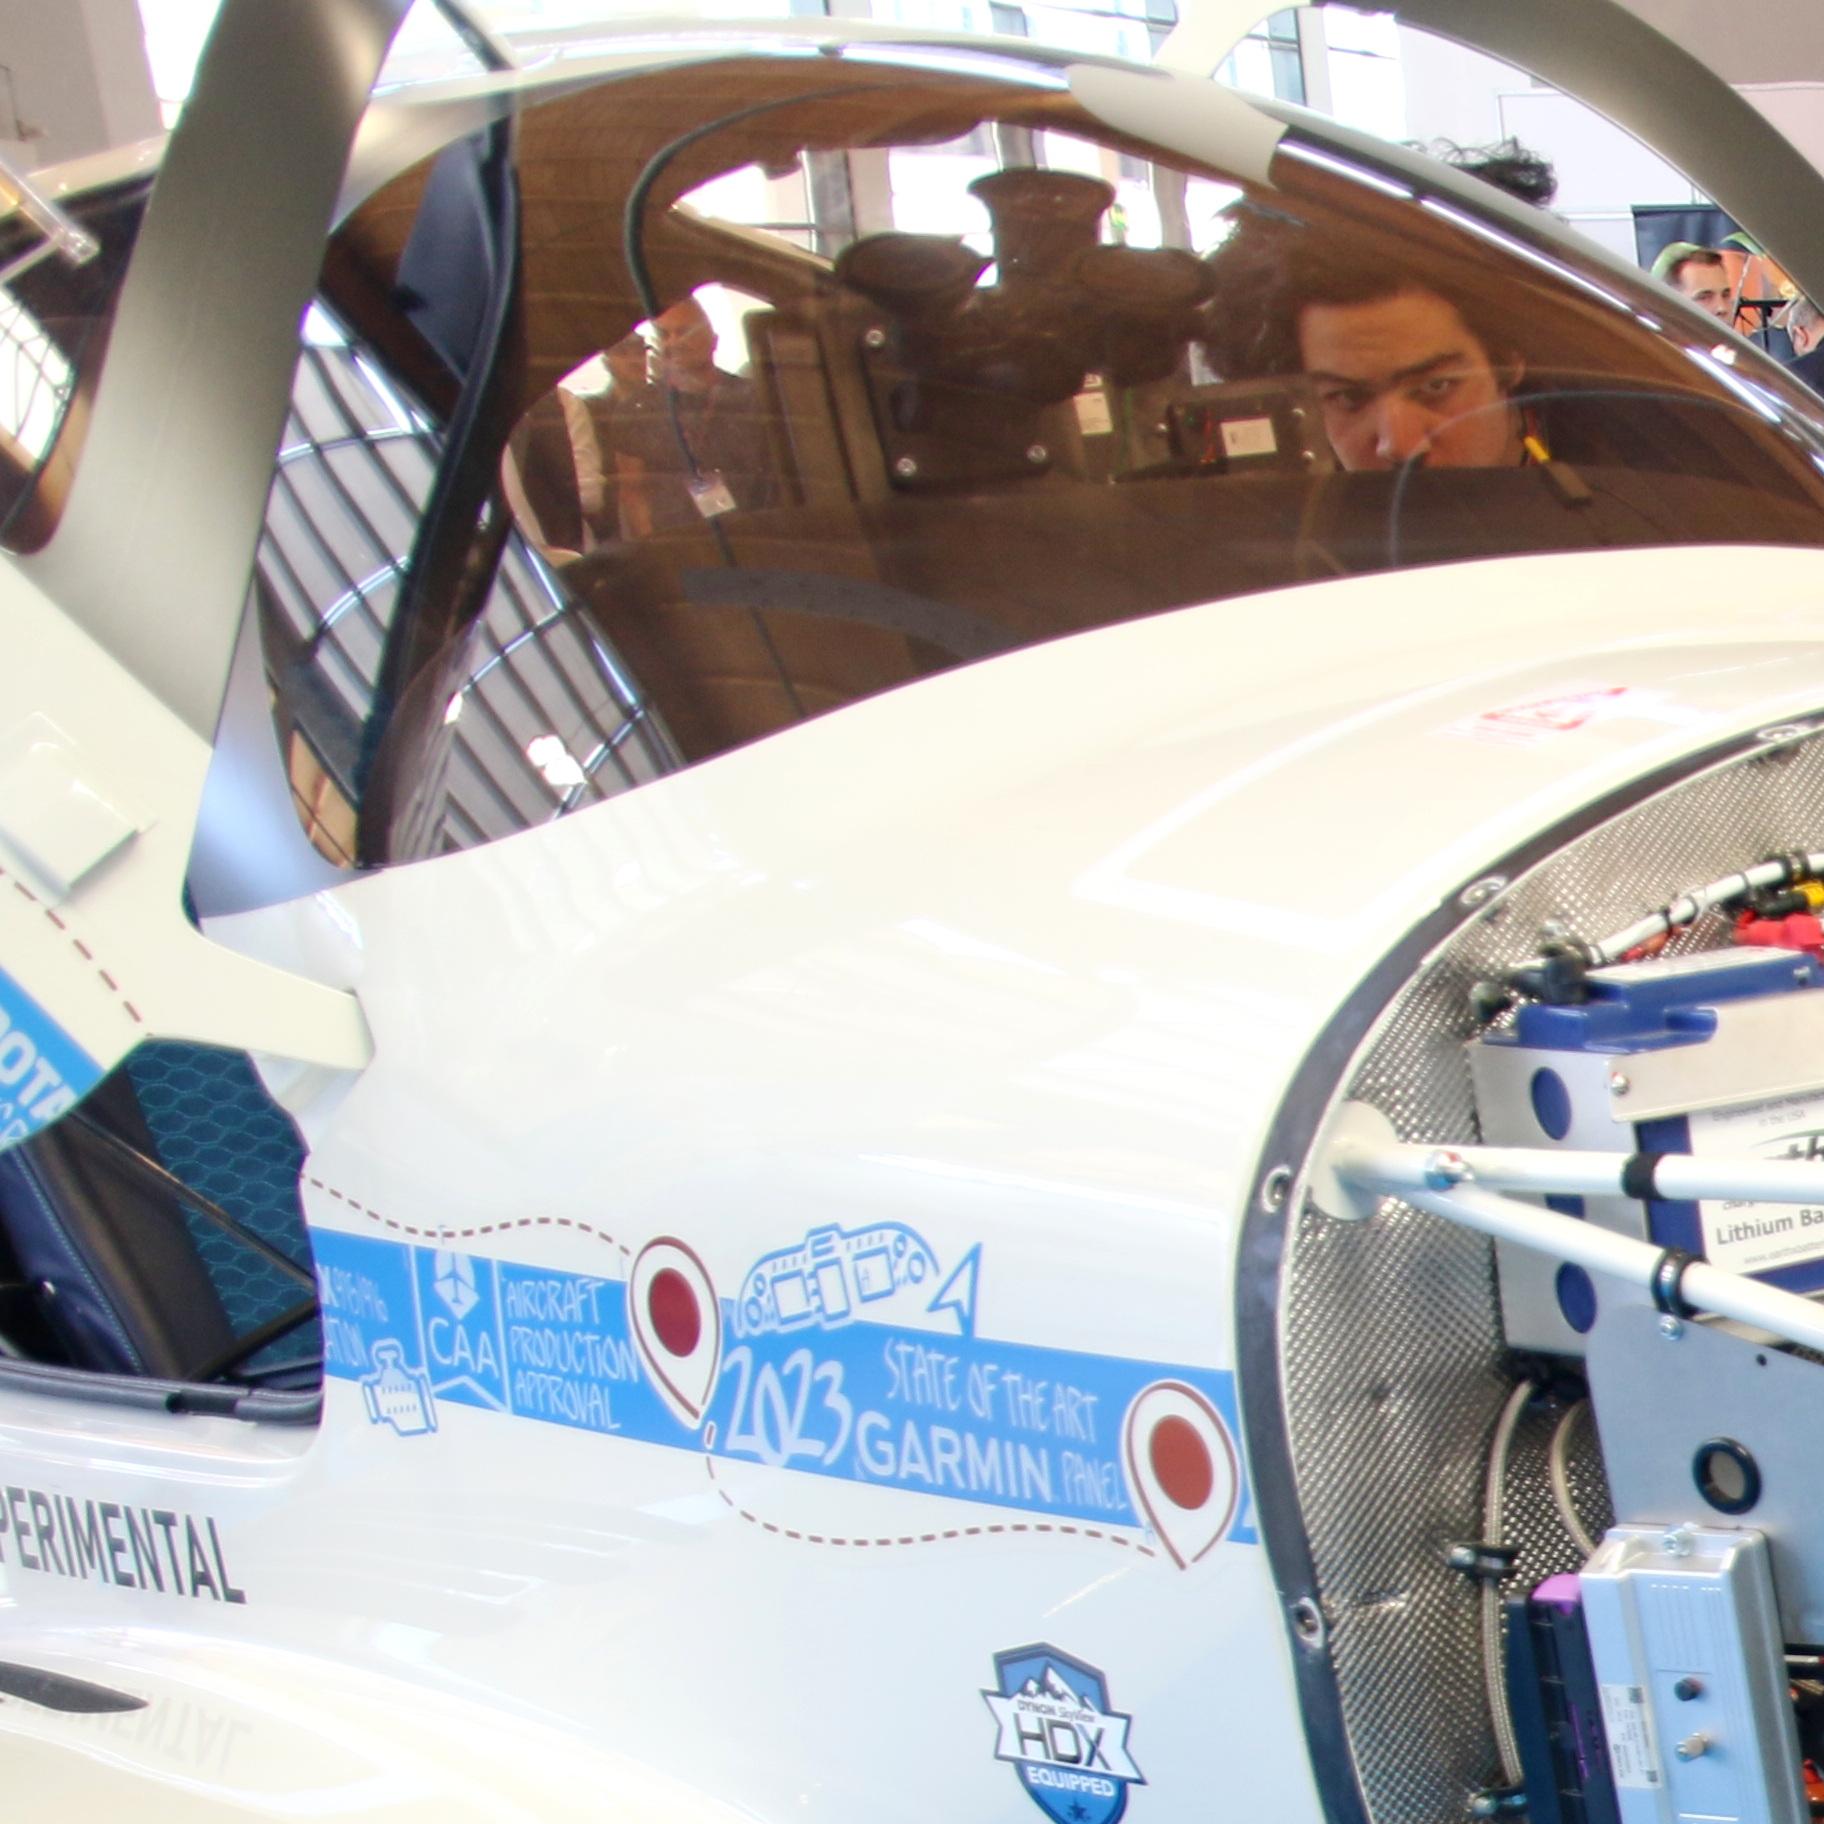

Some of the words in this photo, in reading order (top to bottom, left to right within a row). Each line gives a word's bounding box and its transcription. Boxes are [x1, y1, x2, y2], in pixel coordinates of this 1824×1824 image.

[1716, 1216, 1794, 1246] Lithium
[506, 1278, 605, 1325] AIRCRAFT
[428, 1316, 499, 1379] CAA
[511, 1325, 639, 1384] PRODUCTION
[514, 1369, 622, 1431] APPROVAL
[721, 1344, 853, 1468] 2023
[884, 1338, 961, 1411] STATE
[967, 1361, 999, 1421] OF
[1002, 1371, 1049, 1432] THE
[1051, 1382, 1099, 1444] ART
[856, 1410, 1053, 1503] GARMIN
[1061, 1450, 1128, 1512] PANEL
[1017, 1699, 1057, 1716] DYNON
[1013, 1711, 1114, 1773] HDX
[1026, 1765, 1116, 1798] EQUIPPED
